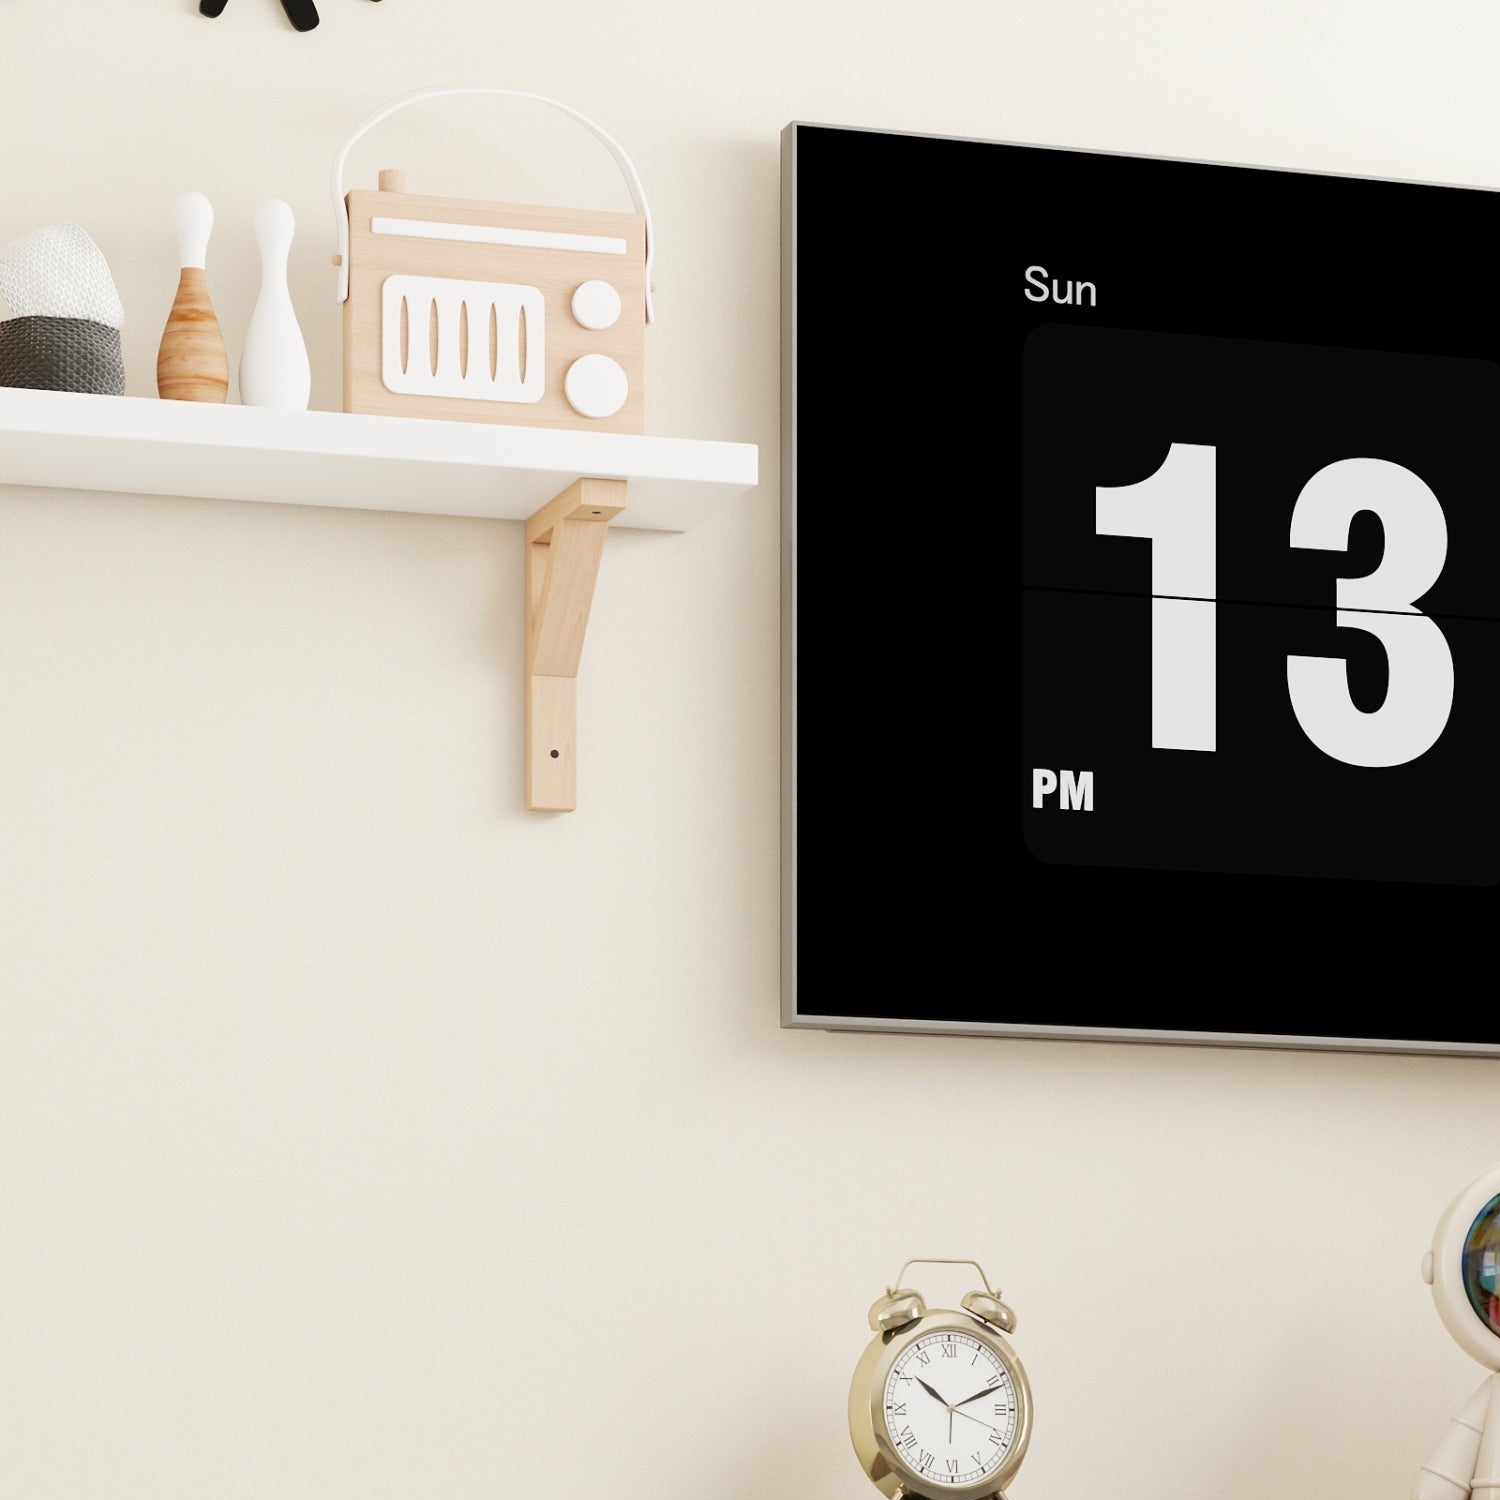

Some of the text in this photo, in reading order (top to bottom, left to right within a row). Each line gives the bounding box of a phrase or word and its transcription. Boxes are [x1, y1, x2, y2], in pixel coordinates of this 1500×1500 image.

[1024, 265, 1097, 307] Sun
[1096, 442, 1455, 768] 13
[1033, 768, 1094, 812] PM
